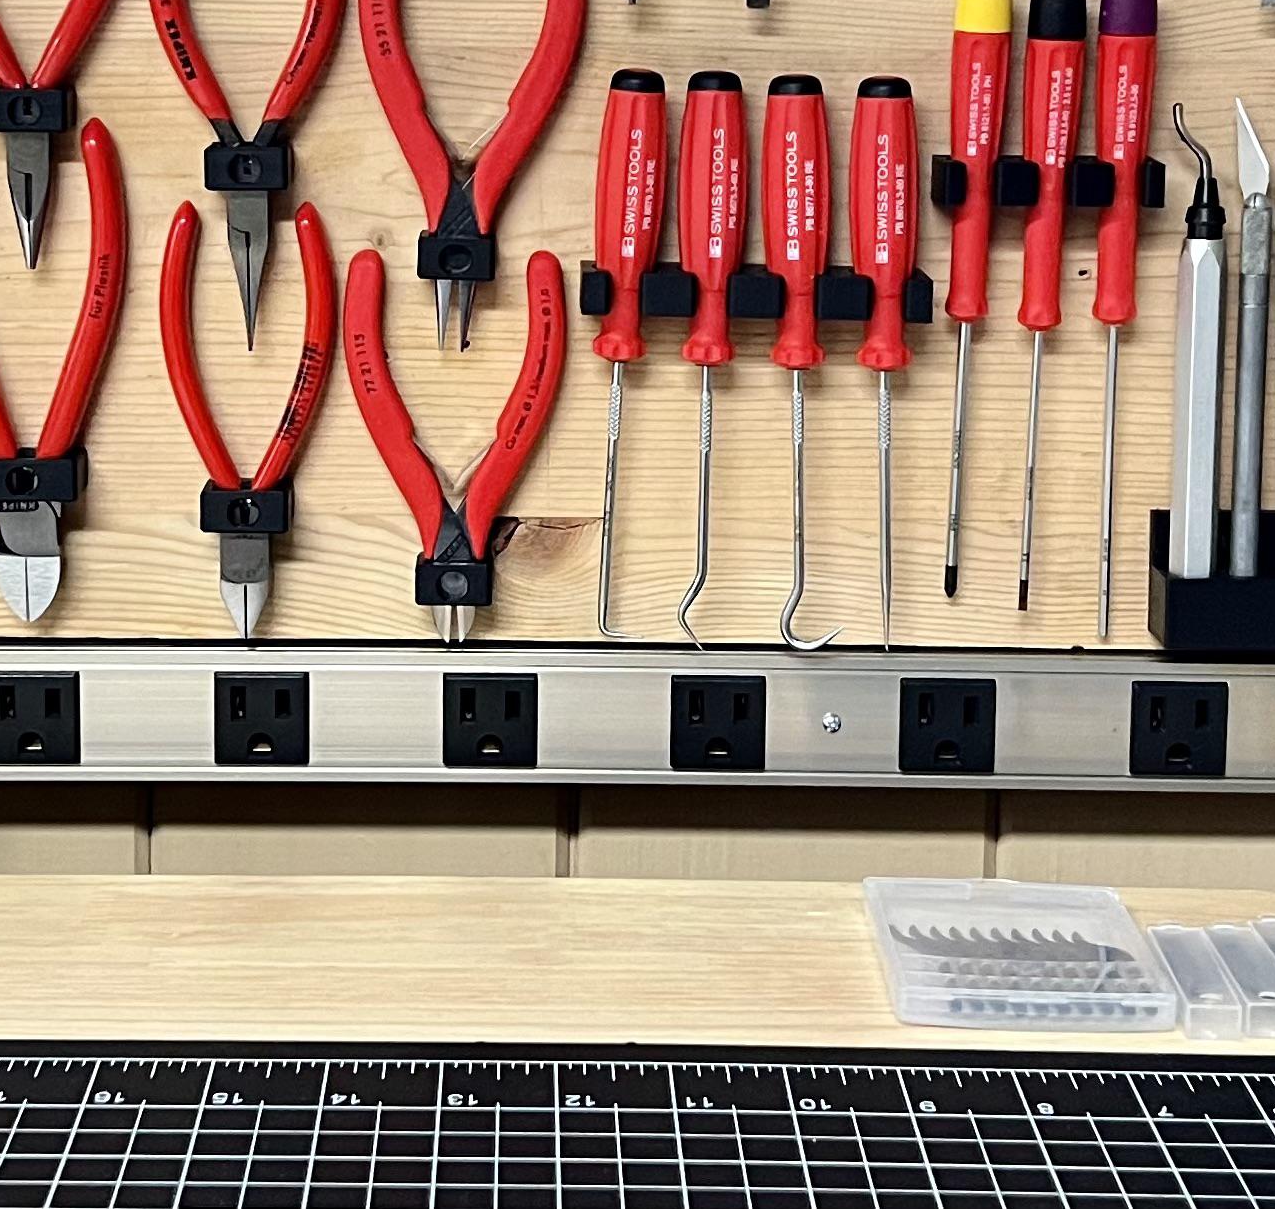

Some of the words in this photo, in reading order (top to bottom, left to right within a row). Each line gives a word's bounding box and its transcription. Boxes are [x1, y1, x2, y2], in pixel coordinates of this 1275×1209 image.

[164, 18, 197, 81] KNIPEX
[970, 62, 981, 102] TOOLS
[1049, 70, 1061, 110] TOOLS
[1117, 65, 1127, 105] TOOLS
[968, 103, 979, 139] SWISS
[1047, 111, 1058, 148] SWISS
[1115, 106, 1126, 143] SWISS
[627, 129, 643, 183] TOOLS
[712, 129, 725, 183] TOOLS
[786, 131, 798, 185] TOOLS
[877, 134, 889, 187] TOOLS
[624, 185, 638, 234] SWISS
[710, 185, 723, 233] SWISS
[787, 187, 799, 236] SWISS
[876, 191, 888, 240] SWISS
[352, 332, 367, 356] 115
[358, 361, 372, 376] 21
[363, 377, 378, 394] 77
[94, 1091, 125, 1103] 16
[212, 1093, 243, 1104] 15
[329, 1093, 360, 1104] 14
[447, 1094, 478, 1105] 13
[565, 1095, 595, 1107] 12
[686, 1097, 713, 1108] 11
[799, 1098, 831, 1110] 10
[919, 1101, 936, 1112] 9
[1037, 1103, 1054, 1115] 8
[1157, 1106, 1174, 1117] 7
